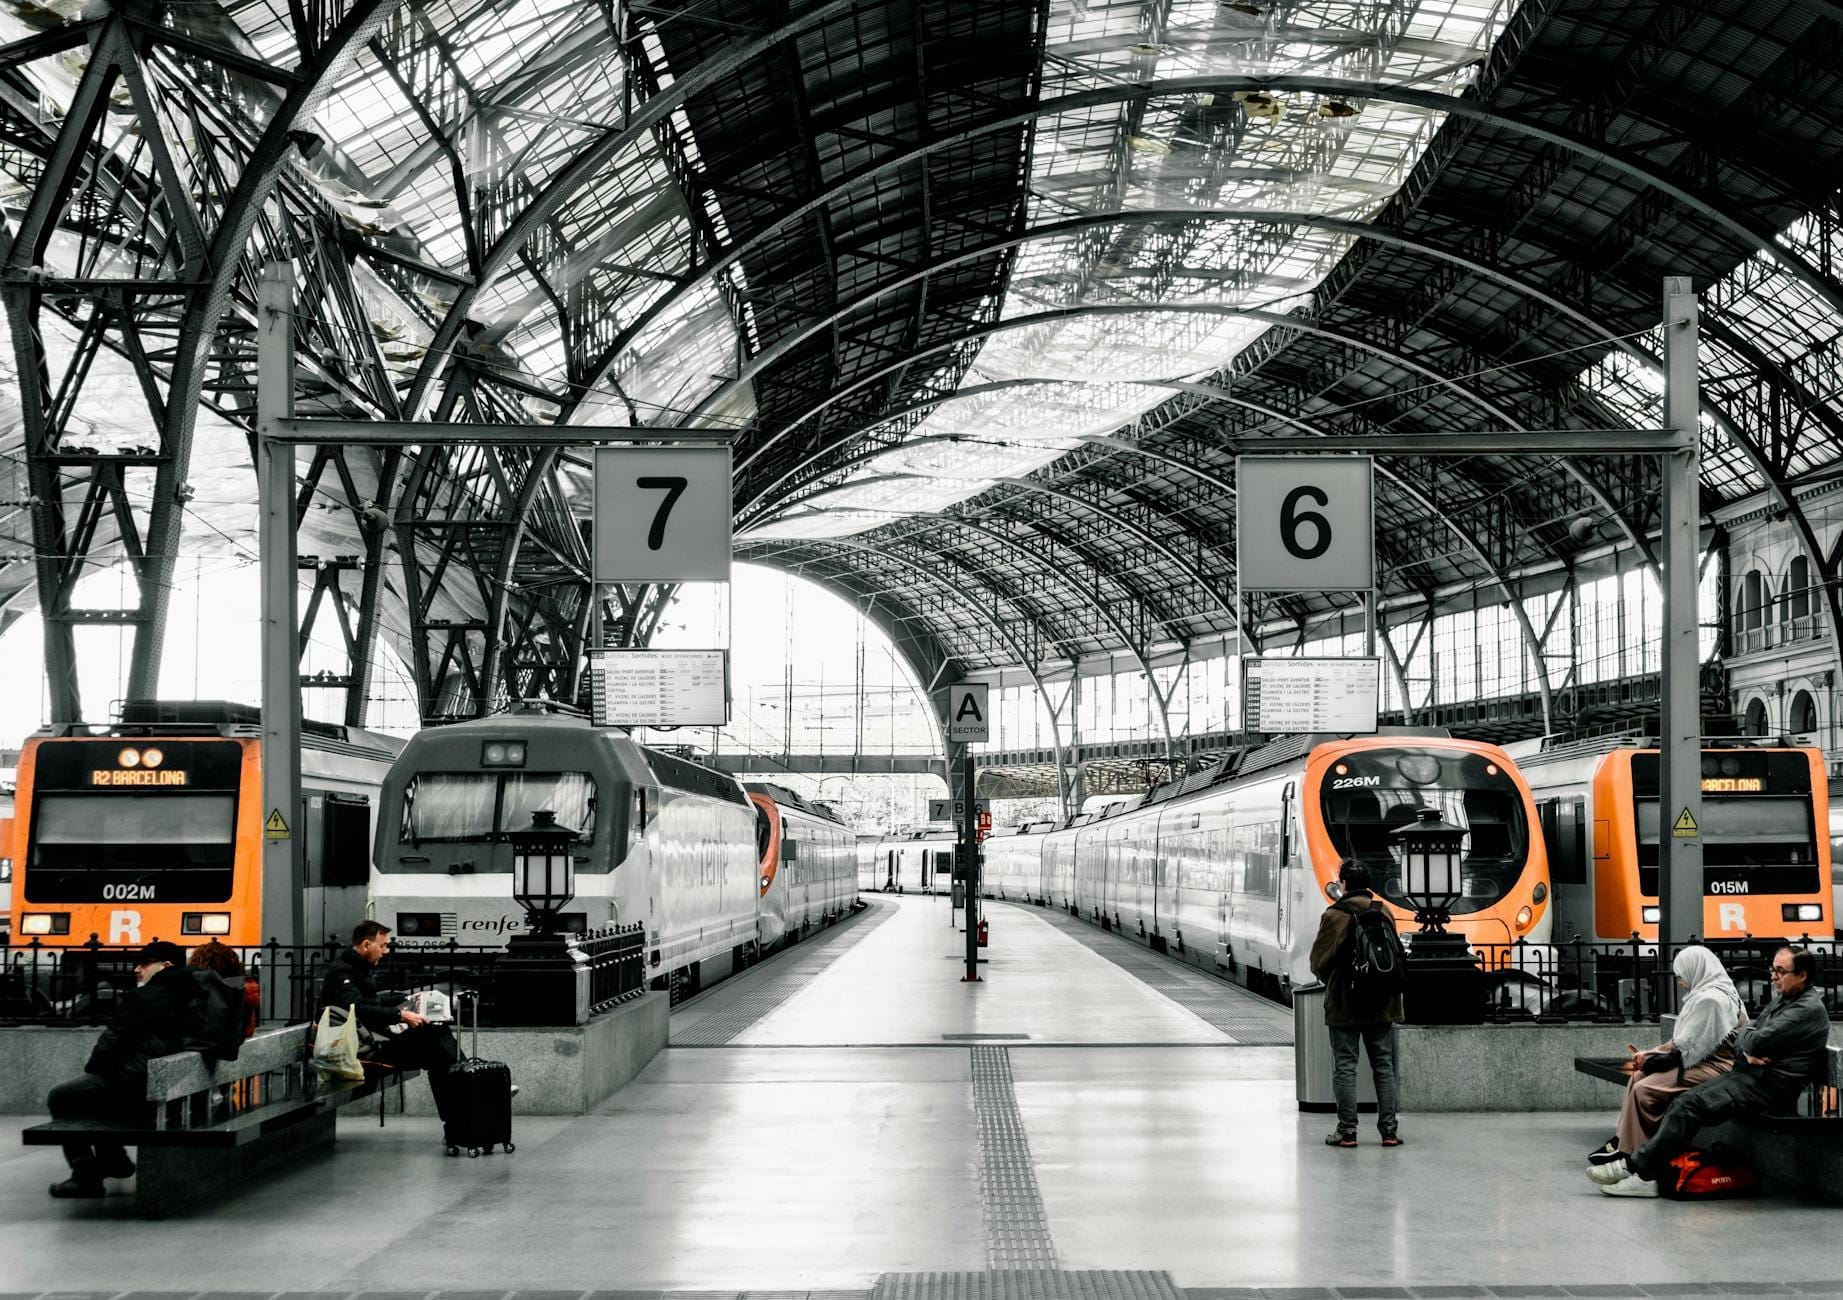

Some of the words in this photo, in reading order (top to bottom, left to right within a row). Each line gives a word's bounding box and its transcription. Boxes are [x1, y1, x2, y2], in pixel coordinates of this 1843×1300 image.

[637, 477, 688, 550] 7
[1280, 486, 1331, 559] 6
[956, 693, 982, 722] A
[93, 771, 110, 785] R2
[112, 771, 185, 785] BARCELONA
[1332, 776, 1380, 790] 226M
[936, 804, 944, 816] 7
[955, 803, 964, 814] B
[103, 884, 155, 900] 002M
[1711, 881, 1748, 894] 015M
[462, 914, 519, 936] renfe
[1719, 903, 1746, 931] R
[110, 910, 142, 944] R
